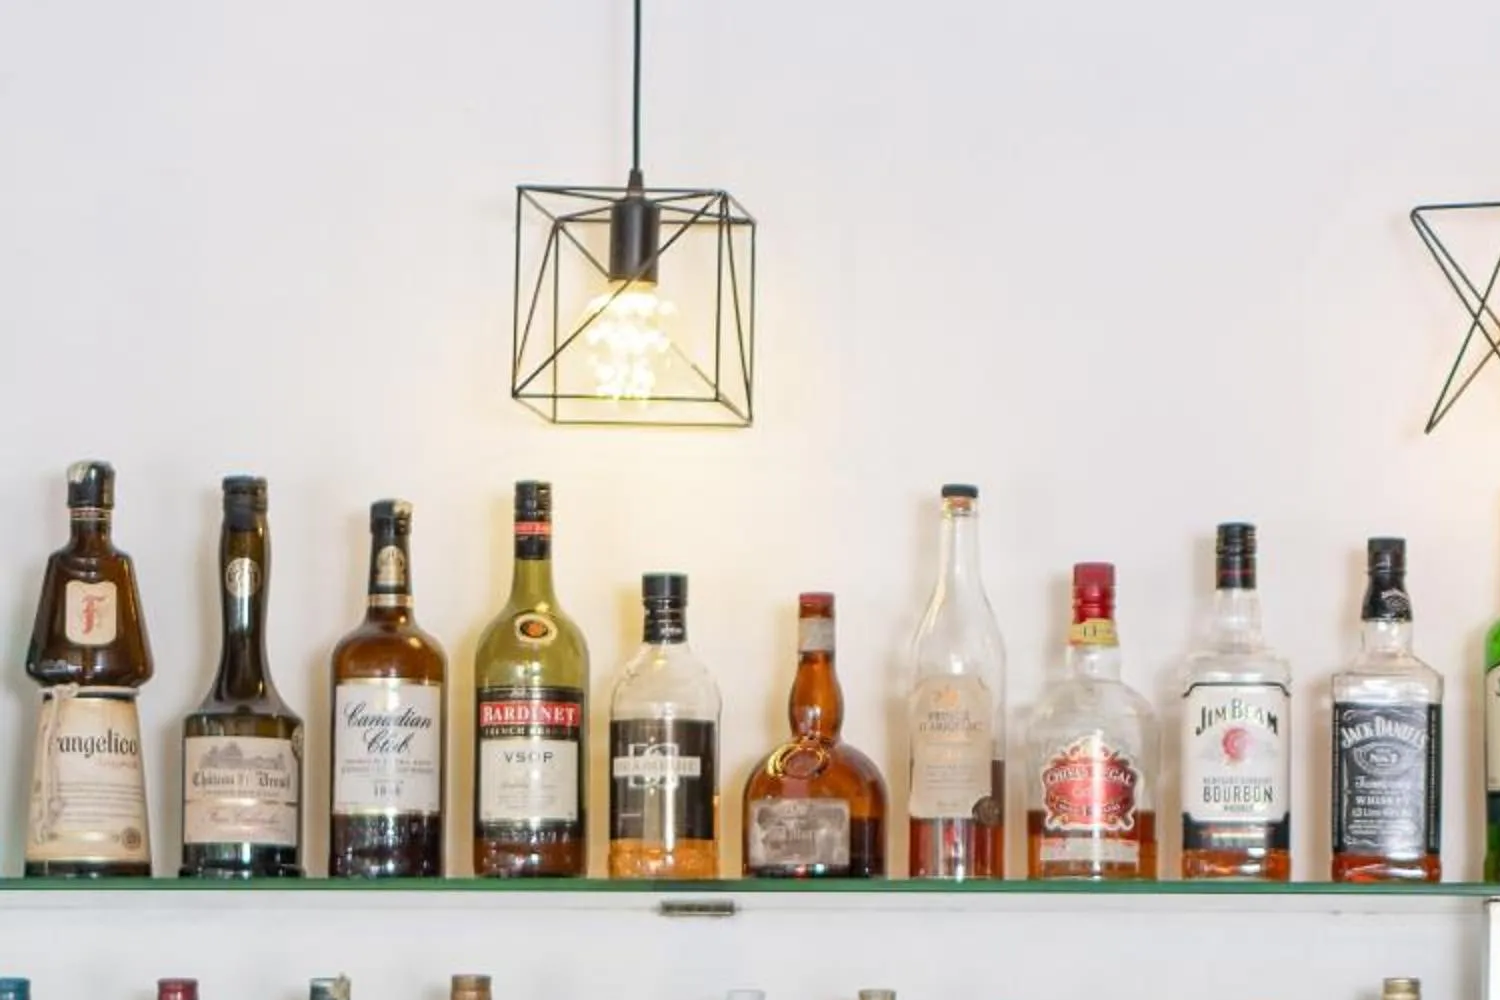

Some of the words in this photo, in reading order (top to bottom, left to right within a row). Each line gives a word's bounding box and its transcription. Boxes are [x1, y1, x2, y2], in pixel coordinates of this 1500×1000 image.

[343, 702, 433, 729] Canadian
[482, 704, 577, 726] BARDINET
[1195, 705, 1227, 736] JIM
[56, 726, 138, 759] angelico
[1341, 721, 1374, 748] JACK
[1100, 768, 1134, 786] EGAL
[1203, 785, 1274, 803] BOURBON
